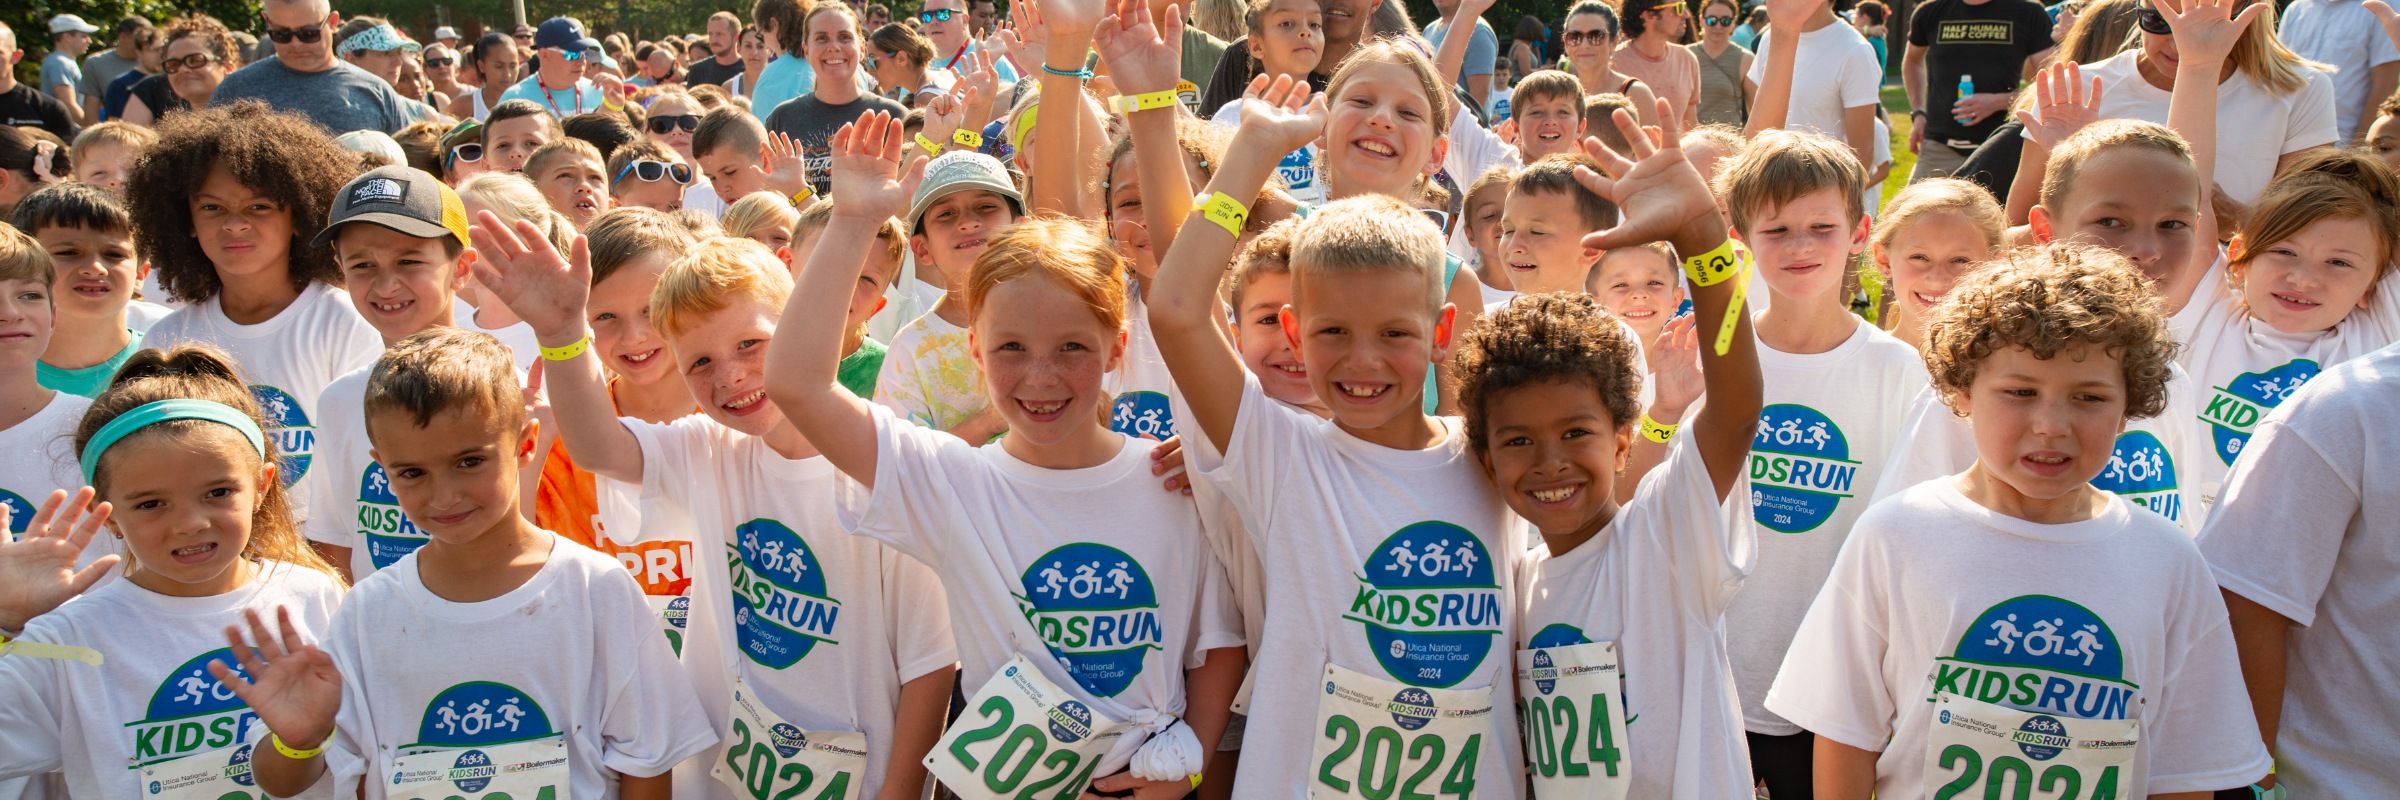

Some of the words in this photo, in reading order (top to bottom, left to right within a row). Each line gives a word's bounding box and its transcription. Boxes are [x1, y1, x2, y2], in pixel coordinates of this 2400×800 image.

[1941, 31, 1967, 40] HALF
[1967, 31, 2007, 40] COFFEE
[1942, 24, 1968, 33] HALF
[1969, 24, 2008, 33] HUMAN
[925, 154, 960, 182] MYRTLE
[355, 182, 385, 196] NORTH
[360, 189, 383, 198] FACE
[1693, 259, 1710, 284] 0956
[1750, 454, 1856, 492] DSRUN
[1762, 500, 1794, 511] Insurance
[1794, 505, 1815, 516] Group
[1763, 493, 1780, 502] Utica
[1781, 495, 1808, 507] National
[1774, 513, 1791, 525] 2024
[1350, 584, 1500, 628] KIDSRUN
[750, 639, 767, 656] 2024
[765, 640, 788, 656] Group
[1407, 643, 1427, 652] Utica
[1428, 643, 1462, 653] National
[1405, 651, 1445, 661] Insurance
[1447, 652, 1470, 662] Group
[1081, 661, 1115, 672] National
[1099, 669, 1125, 680] Group
[1417, 667, 1442, 680] 2024
[1532, 668, 1558, 679] KIDSRUN
[1577, 663, 1616, 673] Boilermaker
[1012, 676, 1031, 696] Insurance
[1030, 693, 1045, 708] Group
[1026, 682, 1044, 699] National
[1335, 685, 1350, 695] Utica
[1350, 690, 1375, 702] National
[1933, 663, 2134, 720] KIDSRUN
[1334, 691, 1361, 703] Insurance
[1361, 699, 1381, 709] Group
[1386, 702, 1438, 717] KIDSRUN
[1047, 707, 1092, 739] KIDSRUN
[1950, 719, 1982, 733] Insurance
[1983, 727, 2005, 738] Group
[1951, 713, 1969, 723] Utica
[1969, 718, 1998, 730] National
[136, 711, 259, 760] KIDS
[767, 728, 808, 748] KIDSRUN
[2012, 731, 2071, 748] KIDSRUN
[2100, 738, 2138, 748] Boilermaker
[525, 757, 567, 769] Boilermaker
[1318, 714, 1482, 800] 2024
[162, 777, 181, 786] Utica
[181, 770, 208, 782] National
[416, 769, 438, 777] National
[426, 774, 443, 782] Group
[448, 766, 497, 780] KIDSRUN
[162, 780, 196, 791] Insurance
[196, 775, 218, 785] Group
